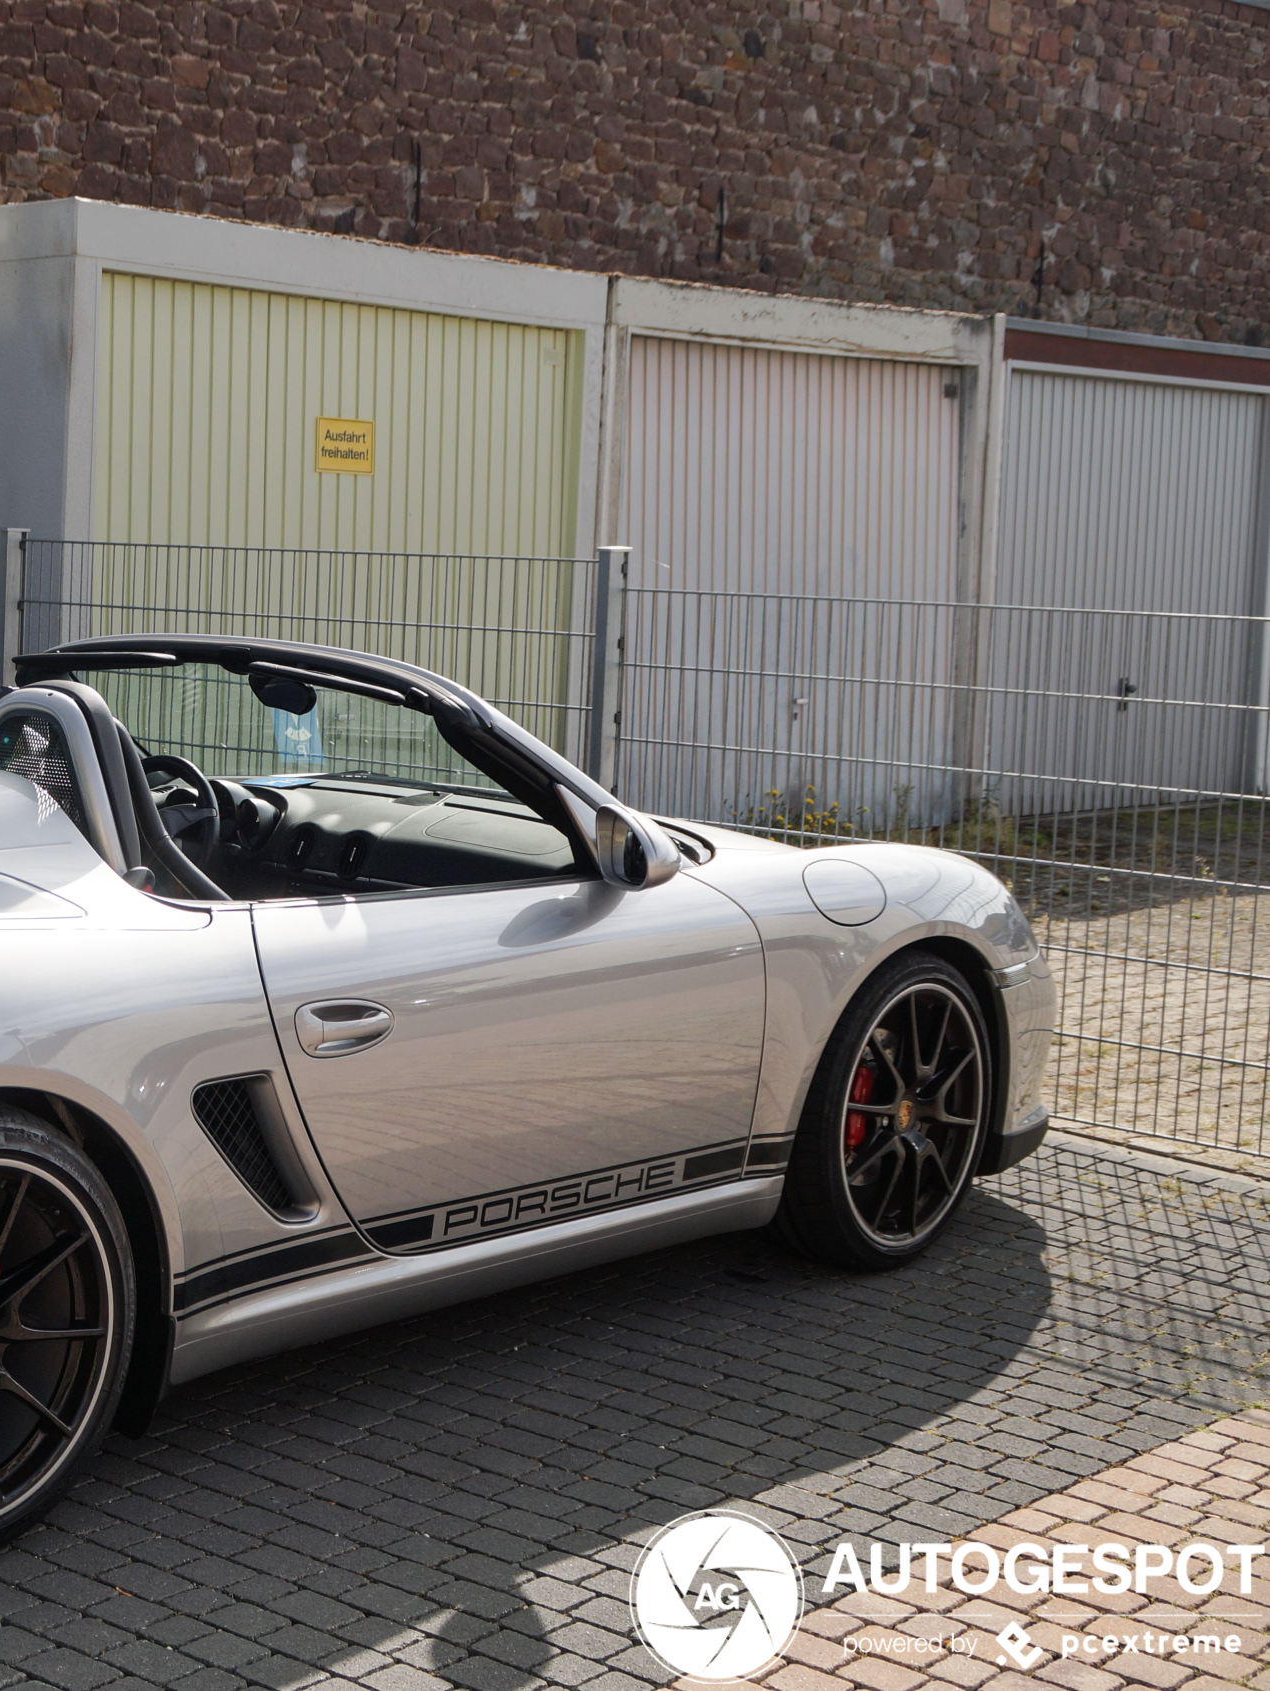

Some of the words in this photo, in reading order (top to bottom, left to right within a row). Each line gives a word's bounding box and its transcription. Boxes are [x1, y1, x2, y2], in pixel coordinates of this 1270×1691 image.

[324, 429, 367, 444] Ausfahrt
[321, 446, 369, 461] freihalten!
[443, 1161, 676, 1236] PORSCHE
